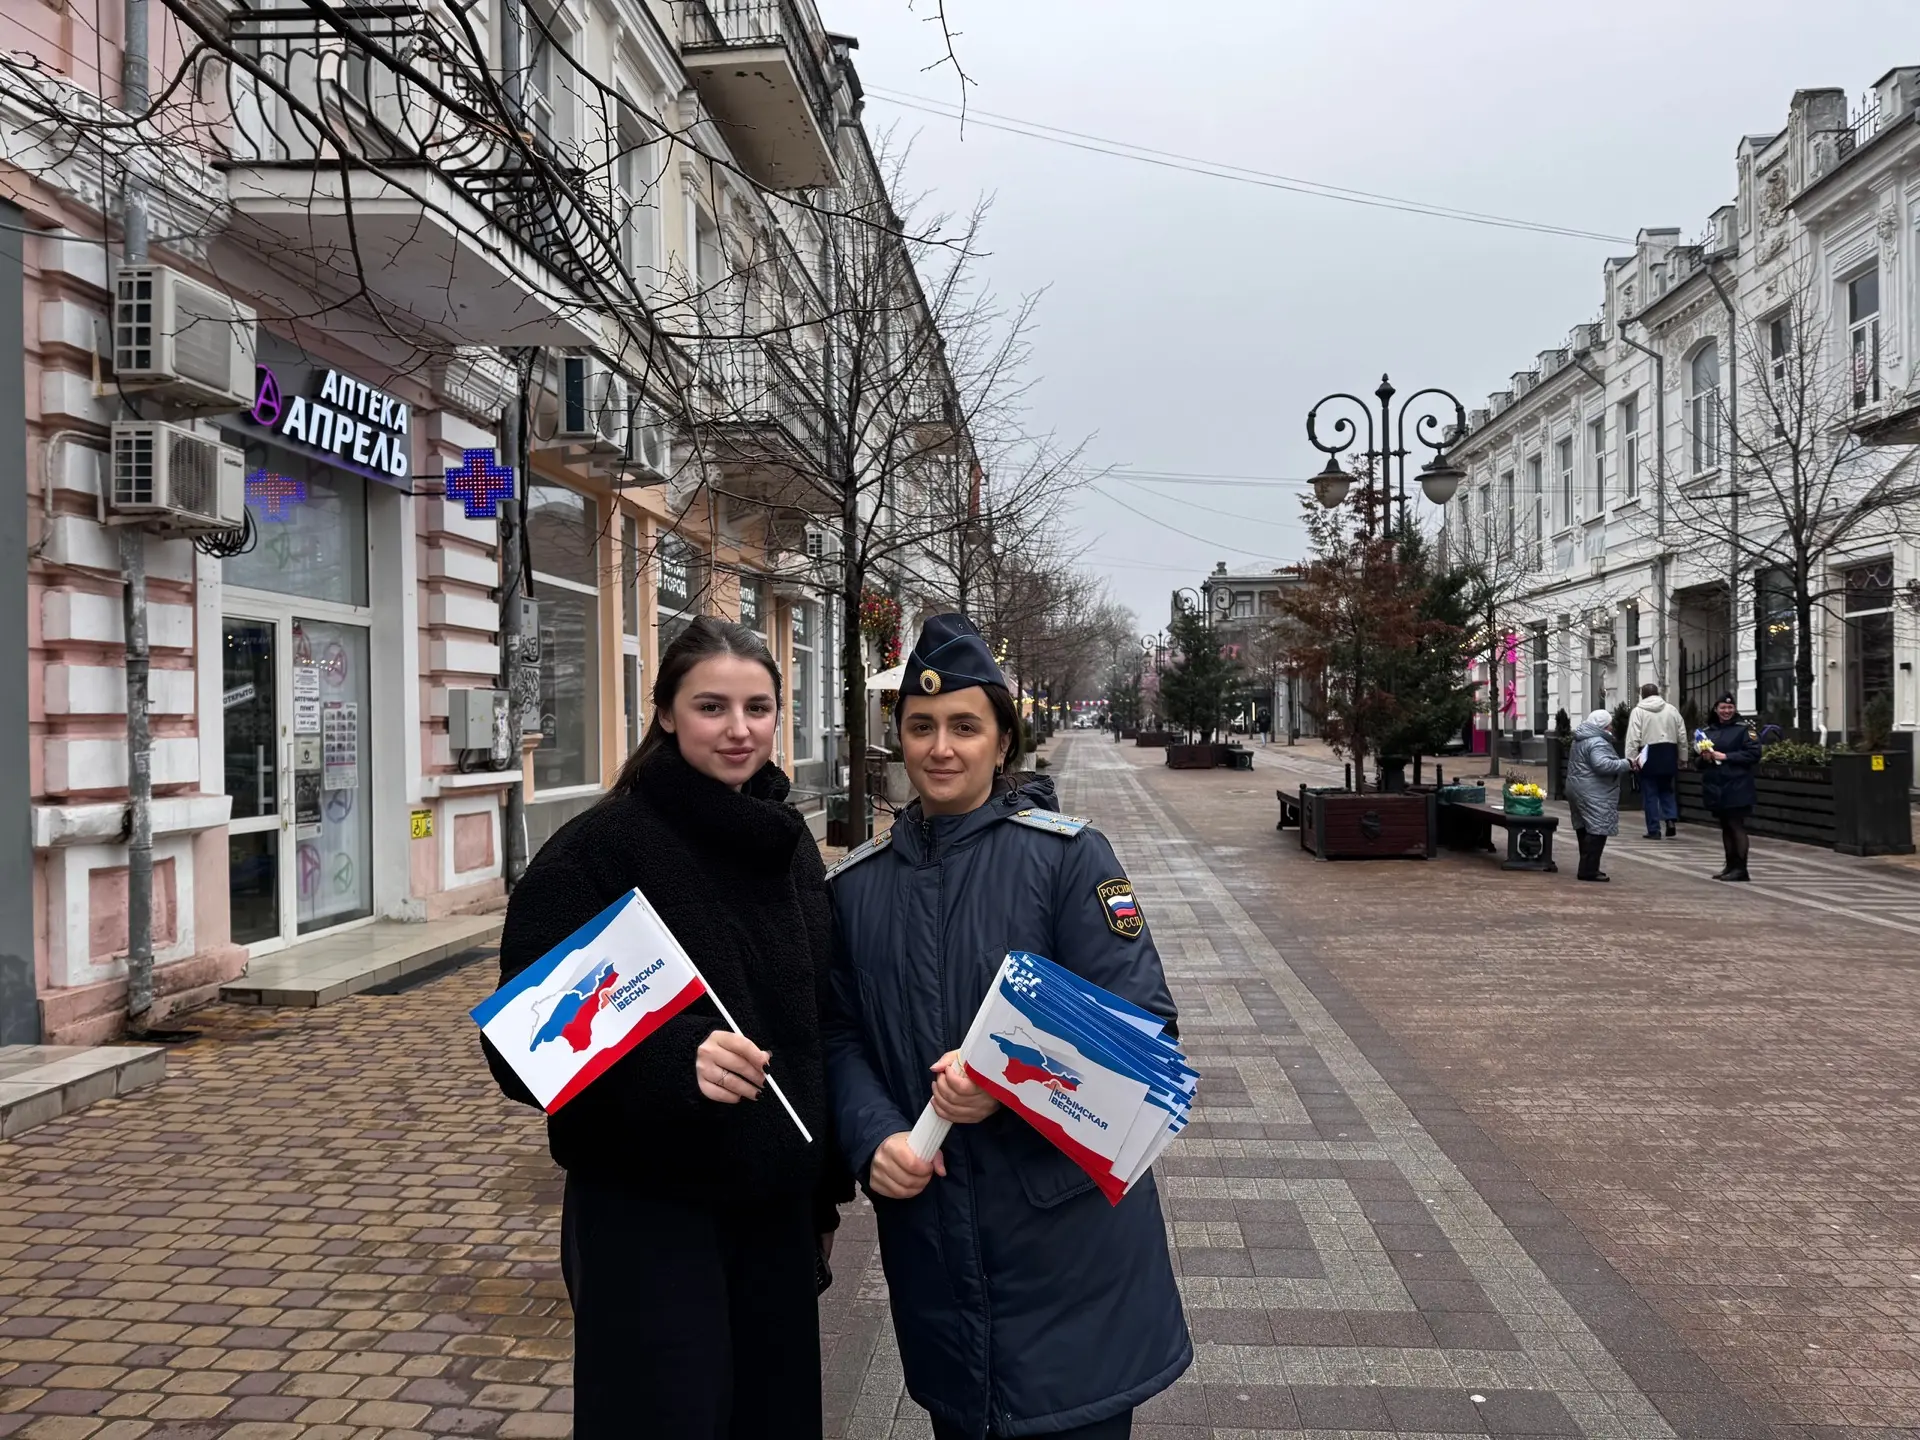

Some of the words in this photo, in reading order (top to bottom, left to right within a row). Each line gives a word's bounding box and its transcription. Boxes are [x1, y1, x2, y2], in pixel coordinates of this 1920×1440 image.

[320, 368, 408, 435] АПТЕКА
[281, 395, 408, 477] АПРЕЛЬ
[664, 574, 688, 599] ГОРОД
[222, 687, 253, 705] ОТКРЫТО
[1100, 884, 1132, 898] РОССИЯ
[1116, 916, 1141, 929] ФССП
[610, 958, 665, 1002] КРЫМСКАЯ
[616, 983, 650, 1010] ВЕСНА
[1051, 1096, 1080, 1122] ВЕСНА
[1054, 1089, 1108, 1130] КРЫМСКАЯ
